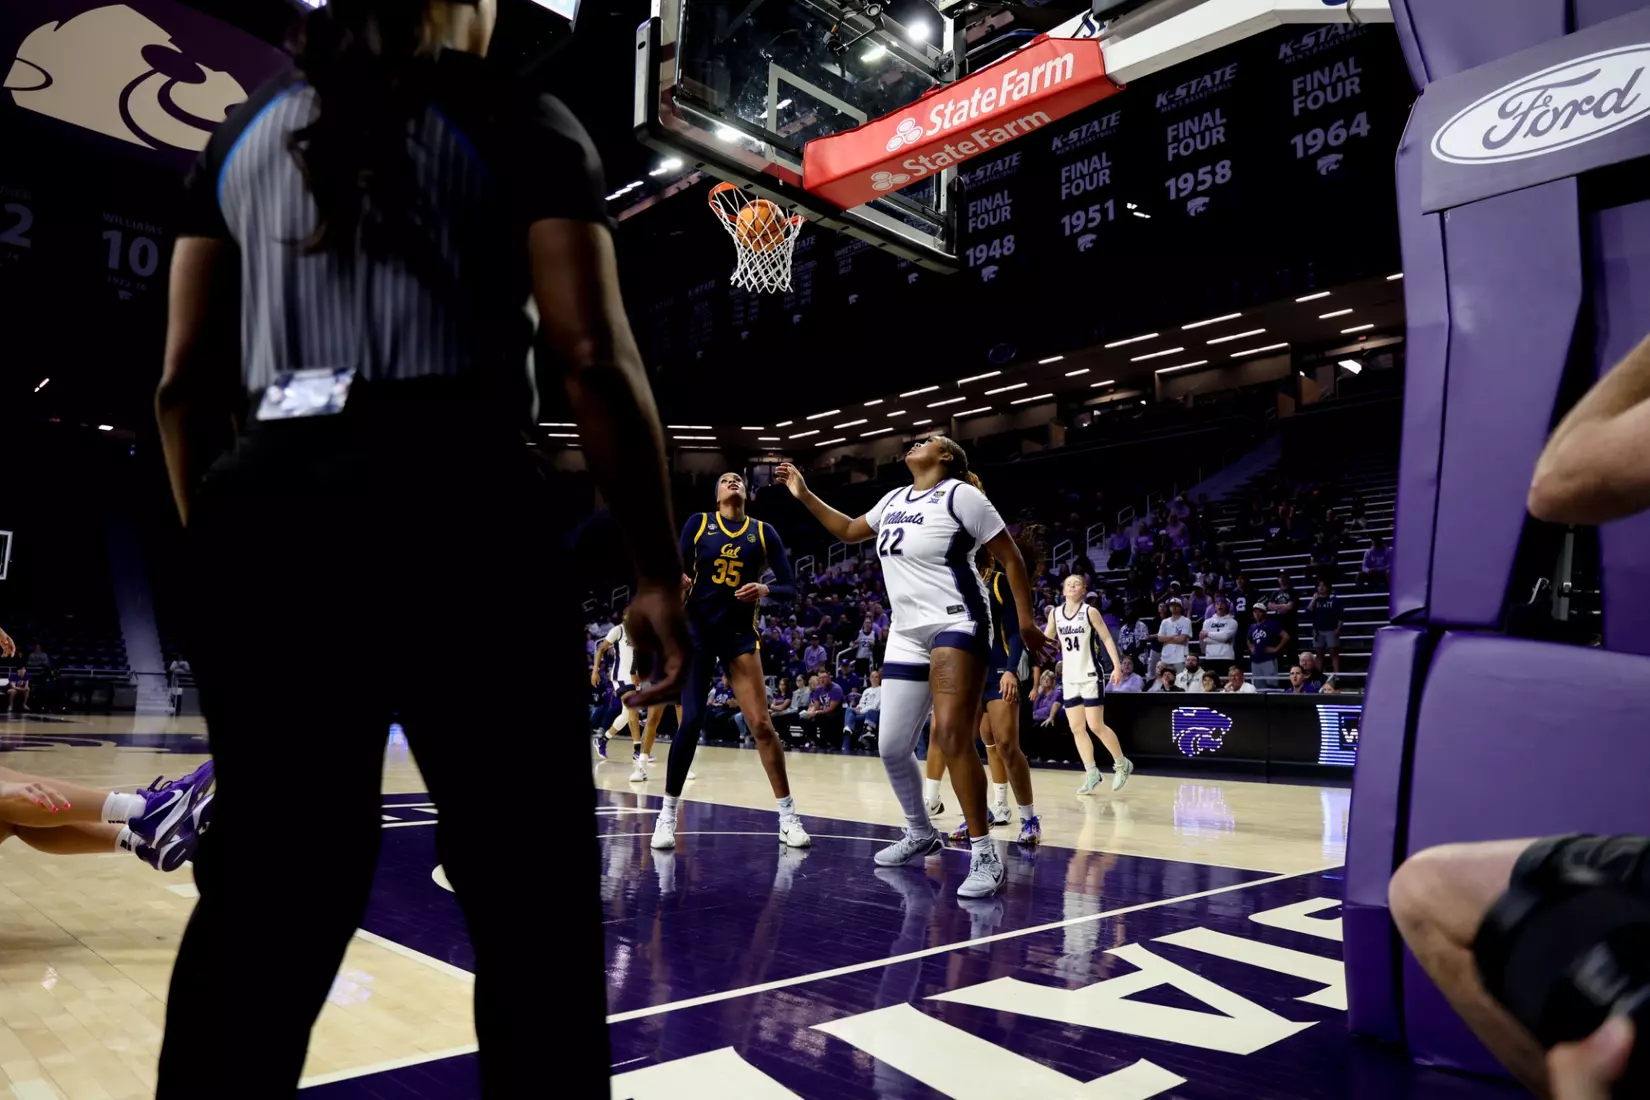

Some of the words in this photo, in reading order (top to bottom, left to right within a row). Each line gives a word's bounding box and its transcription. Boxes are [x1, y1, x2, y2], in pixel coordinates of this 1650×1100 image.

[1155, 62, 1239, 109] K-STATE
[1292, 56, 1363, 97] FINAL
[1292, 76, 1362, 117] FOUR
[1482, 67, 1646, 150] Ford
[1051, 110, 1122, 151] K-STATE
[1167, 107, 1228, 144] FINAL
[1290, 111, 1371, 159] 1964
[1167, 126, 1227, 162] FOUR
[962, 150, 1023, 185] K-STATE
[1060, 150, 1113, 184] FINAL
[1060, 169, 1112, 200] FOUR
[1165, 159, 1232, 200] 1958
[968, 189, 1013, 218] FINAL
[968, 205, 1012, 234] FOUR
[1060, 198, 1115, 236] 1951
[102, 210, 163, 235] WILLIAMS
[102, 229, 159, 277] 10
[965, 234, 1016, 267] 1948
[720, 543, 742, 558] Cal
[879, 527, 905, 557] 22
[711, 558, 744, 587] 35
[1059, 625, 1085, 635] Wildcats
[1065, 636, 1080, 652] 34
